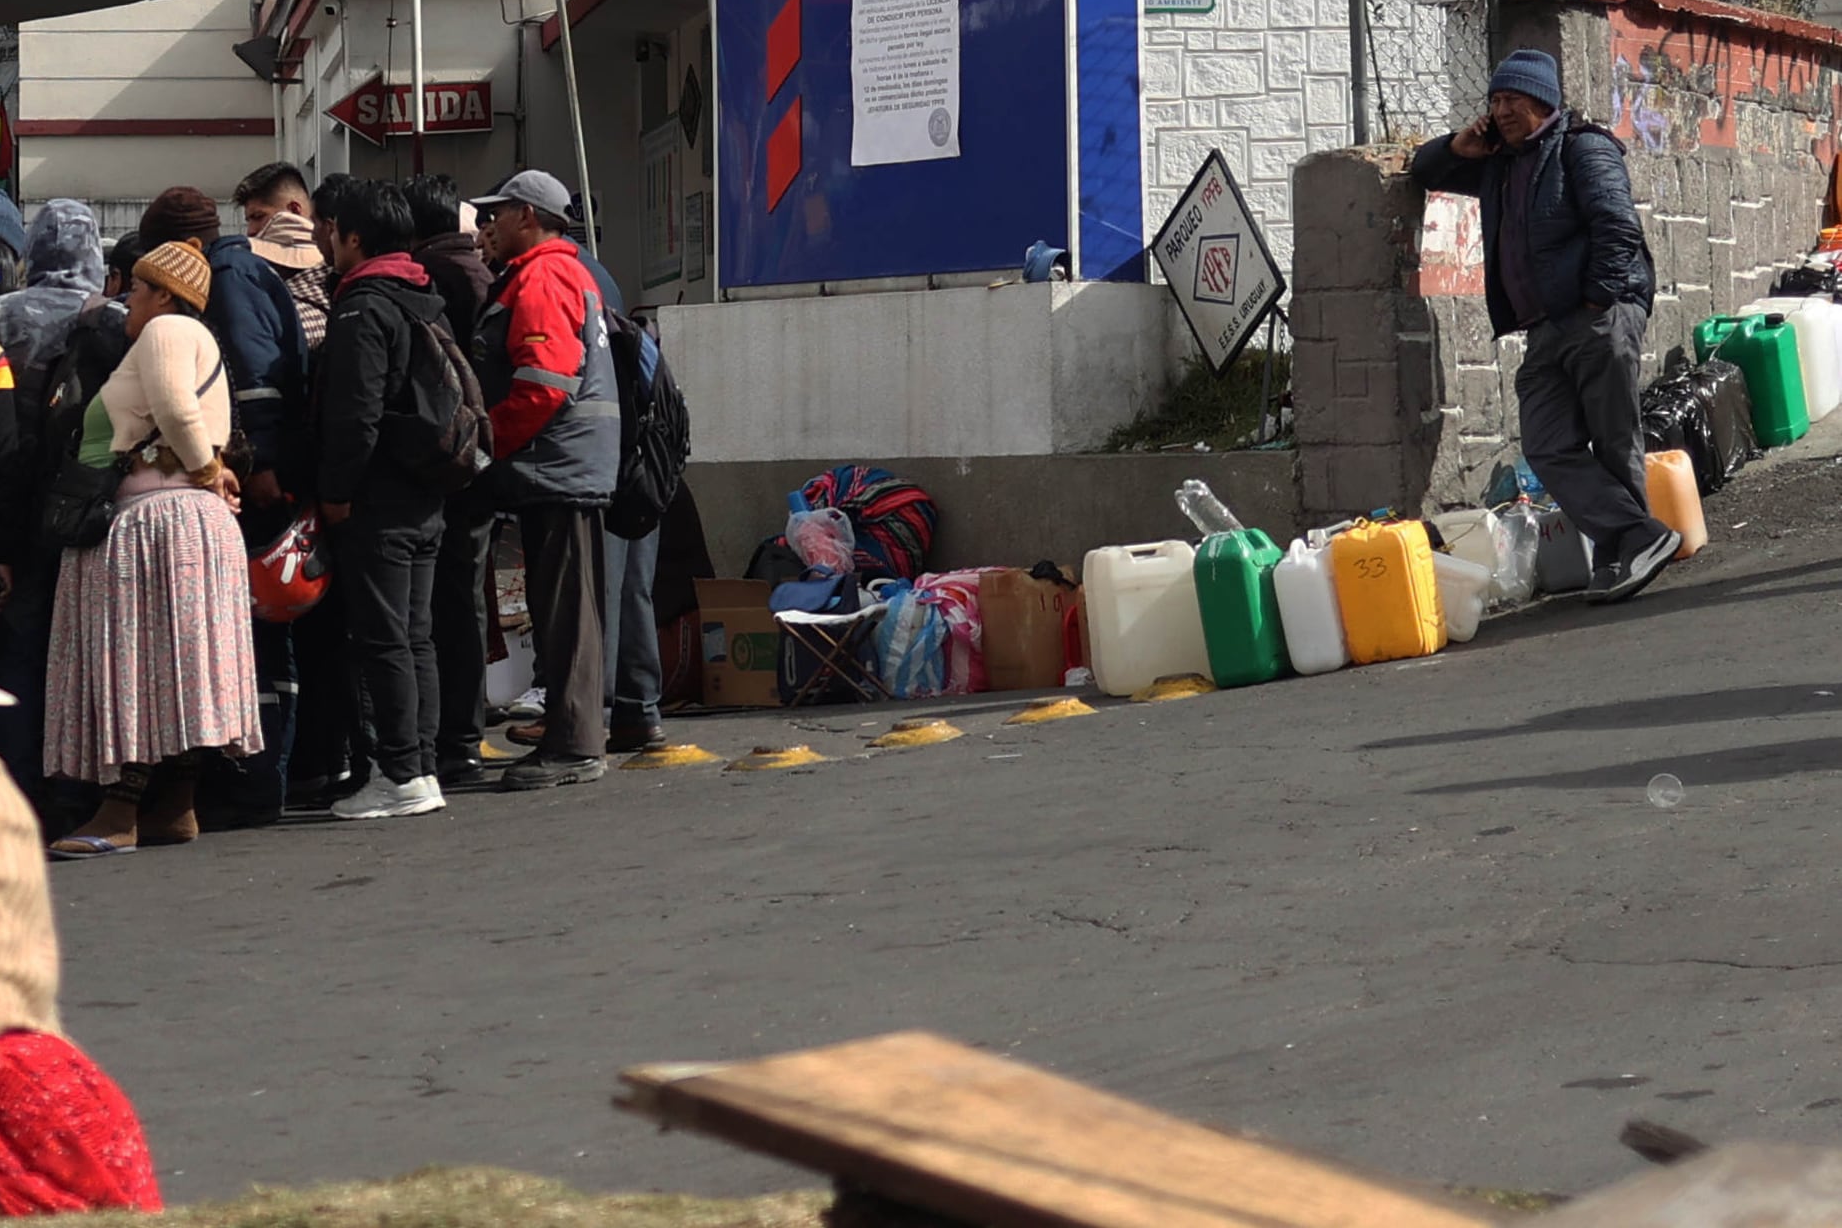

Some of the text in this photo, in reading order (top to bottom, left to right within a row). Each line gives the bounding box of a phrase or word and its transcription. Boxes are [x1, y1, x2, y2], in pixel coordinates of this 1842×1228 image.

[1165, 176, 1223, 264] PARQUEO YPFB
[1201, 247, 1232, 294] YPFB
[1238, 277, 1268, 321] URUGUAY
[1352, 556, 1387, 579] 33
